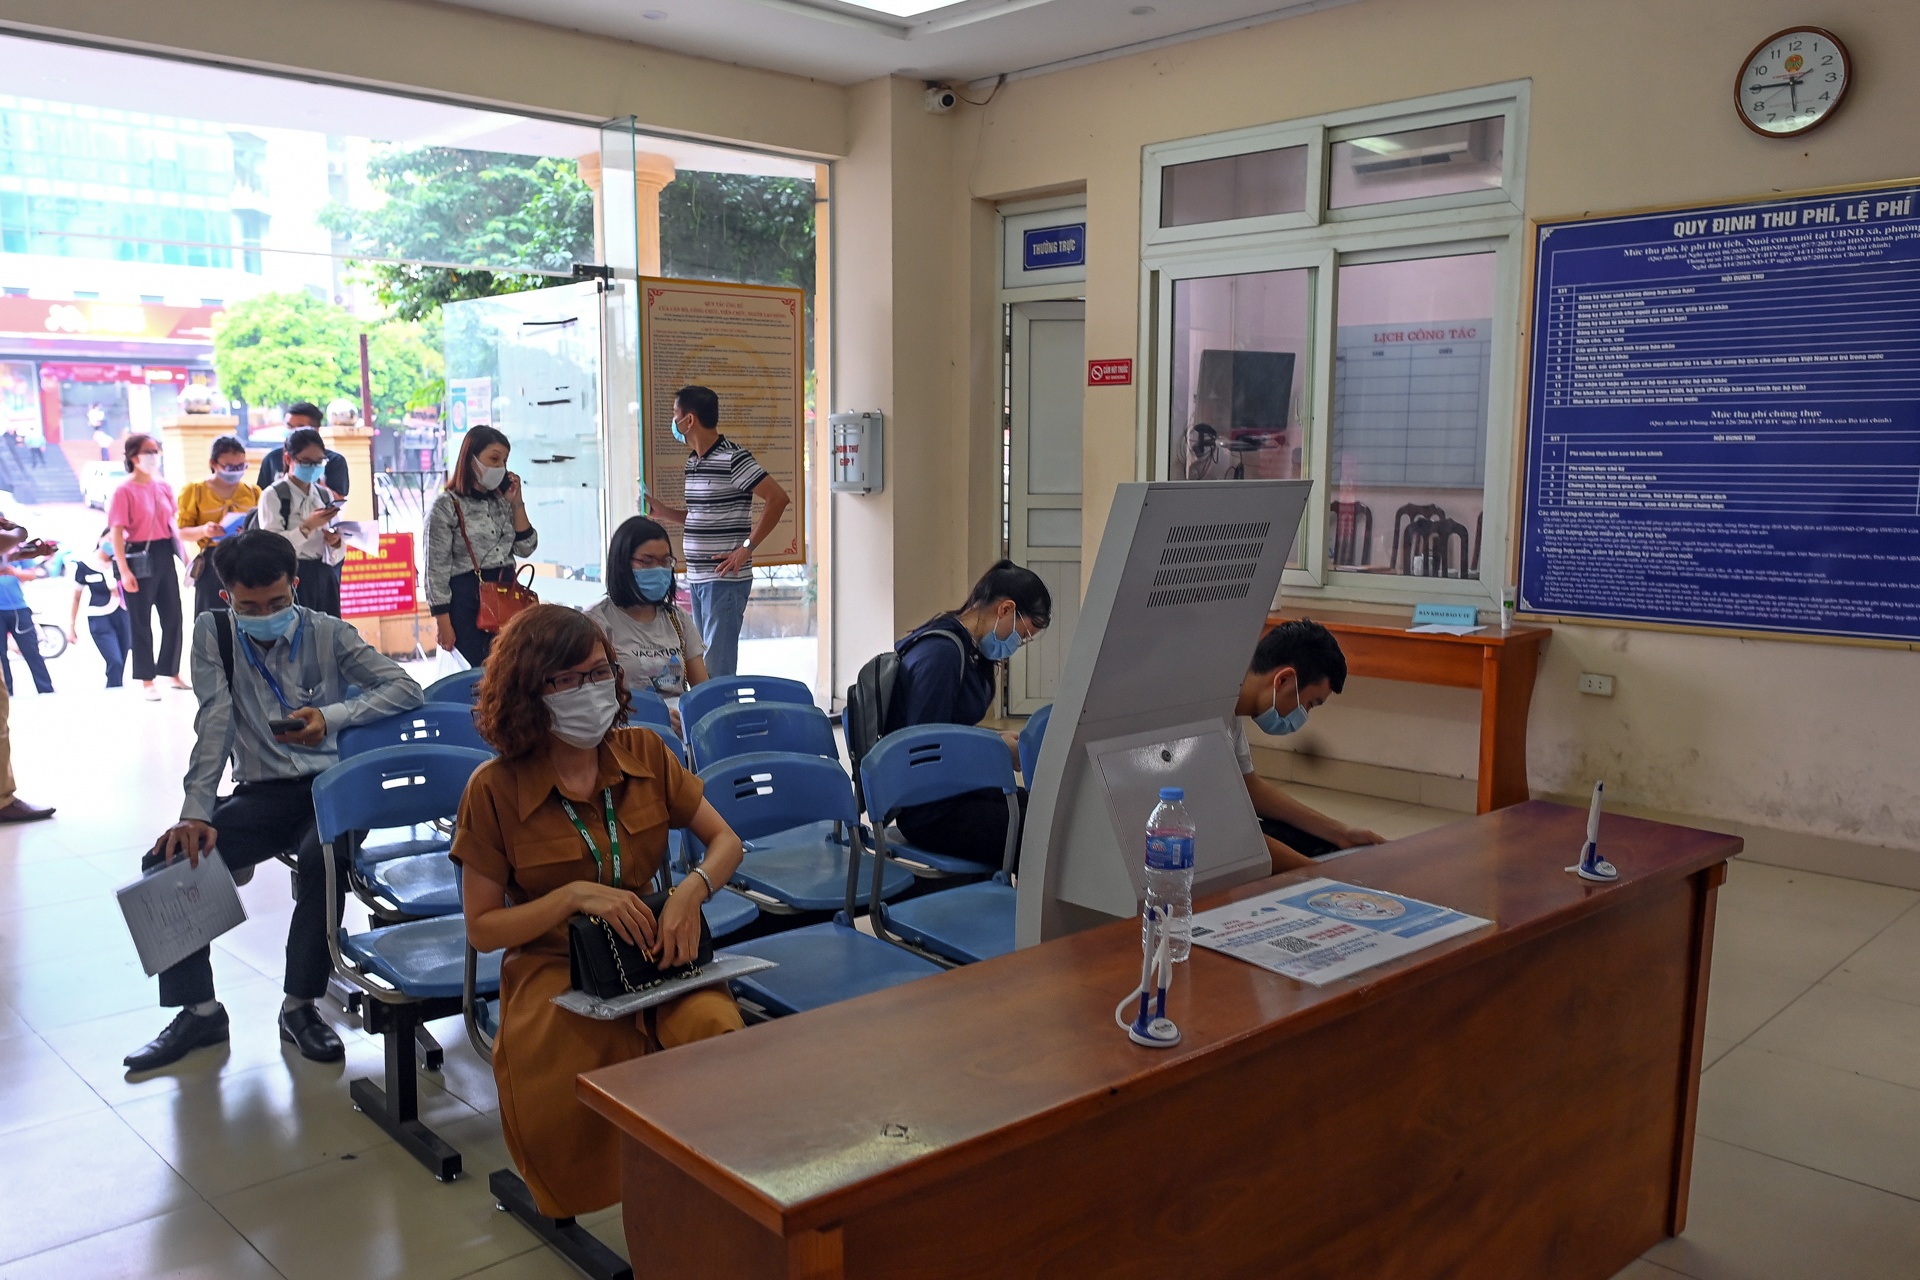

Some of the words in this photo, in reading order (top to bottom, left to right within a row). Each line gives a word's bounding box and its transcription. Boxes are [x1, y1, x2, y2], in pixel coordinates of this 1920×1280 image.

[1789, 41, 1802, 51] 12
[1814, 42, 1818, 52] 1
[1771, 50, 1781, 59] 11
[1821, 55, 1833, 66] 2
[1755, 65, 1767, 75] 10
[1825, 73, 1837, 82] 3
[1818, 91, 1831, 101] 4
[1754, 101, 1765, 111] 8
[1805, 107, 1816, 117] 5
[1767, 113, 1777, 123] 7
[1785, 115, 1795, 125] 6
[1674, 219, 1708, 237] QUY
[1712, 215, 1756, 235] ĐỊNH
[1762, 210, 1796, 228] THU
[1803, 204, 1840, 224] PHÍ,
[1847, 200, 1870, 222] LỆ
[1876, 198, 1911, 217] PHÍ
[1033, 240, 1058, 256] THƯỜNG
[1059, 238, 1076, 254] TRỰC
[1374, 332, 1403, 344] LỊCH
[1408, 328, 1445, 341] CÔNG
[1449, 326, 1476, 339] TÁC
